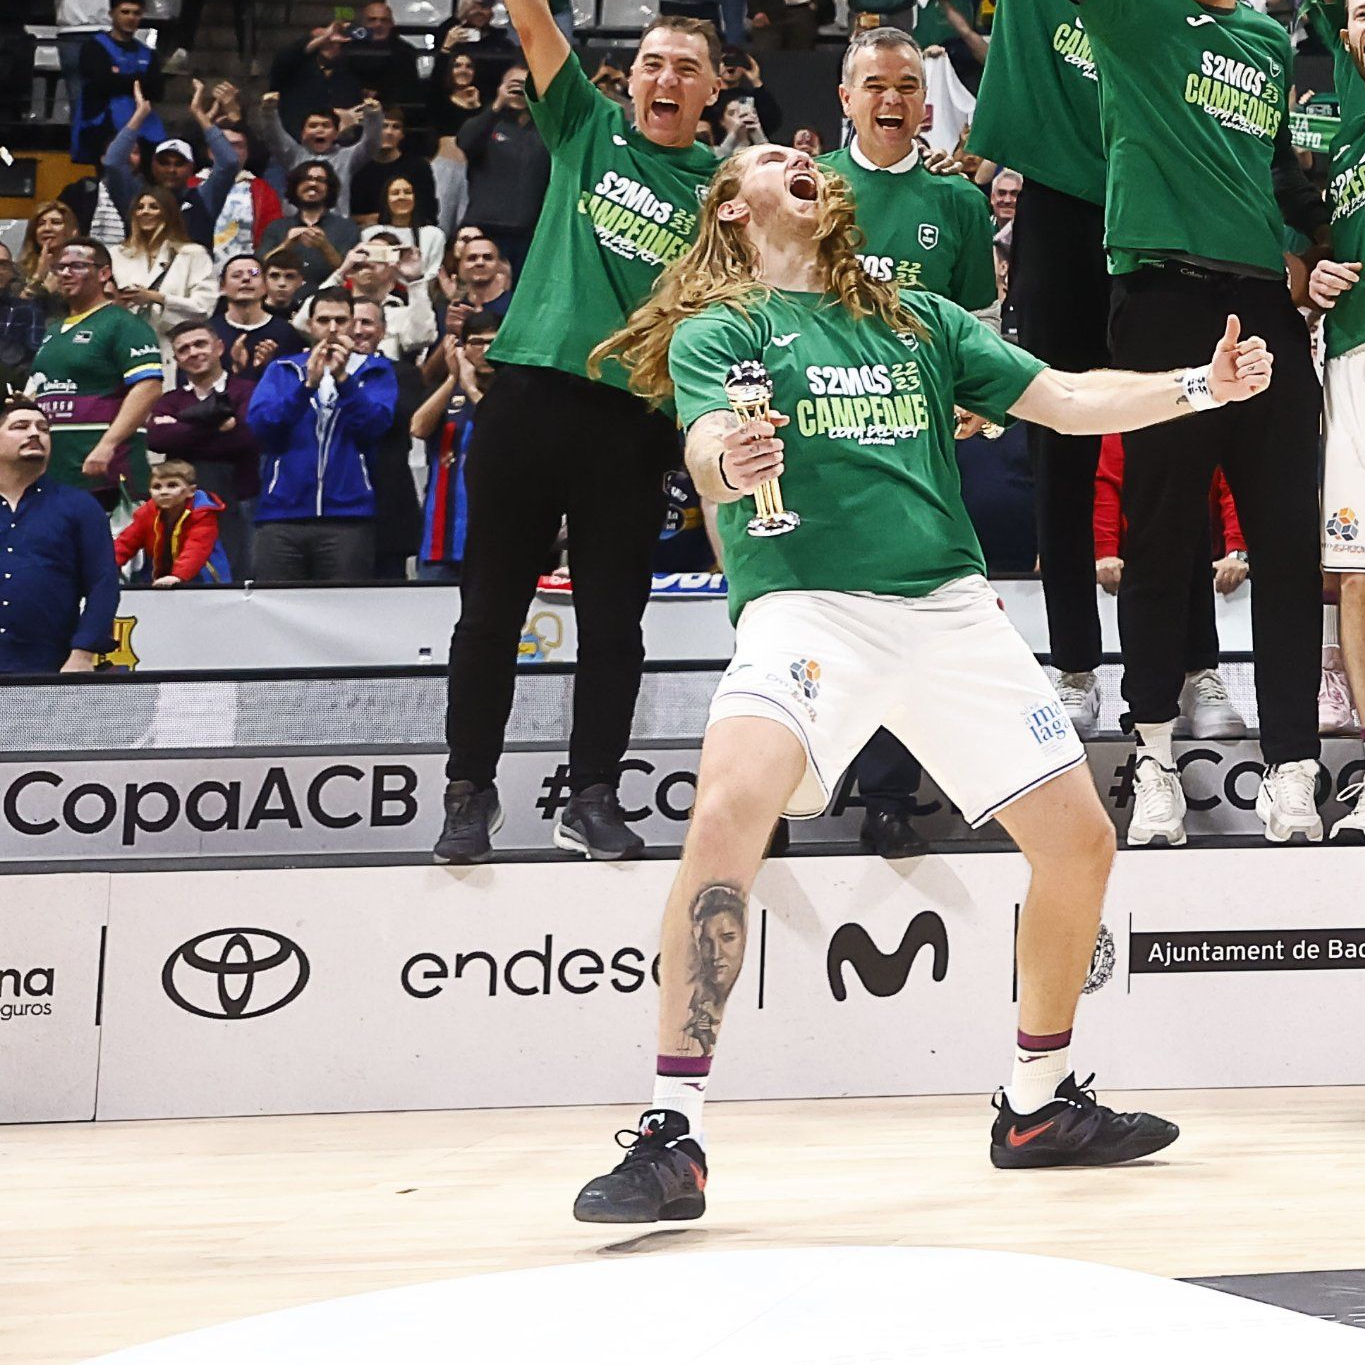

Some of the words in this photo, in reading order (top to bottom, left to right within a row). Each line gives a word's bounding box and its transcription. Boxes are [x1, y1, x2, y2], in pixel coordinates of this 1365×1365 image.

[1201, 50, 1266, 95] S2MOS
[1184, 72, 1282, 141] CAMPEONES
[806, 364, 893, 395] S2MOS
[892, 361, 919, 377] 22
[894, 375, 921, 392] 23
[795, 393, 930, 437] CAMPEONE
[828, 424, 866, 440] COPA
[888, 424, 921, 440] REY
[3, 764, 419, 846] CopaACB
[400, 934, 661, 998] endes
[1148, 938, 1285, 966] Ajuntament
[1292, 937, 1321, 961] de
